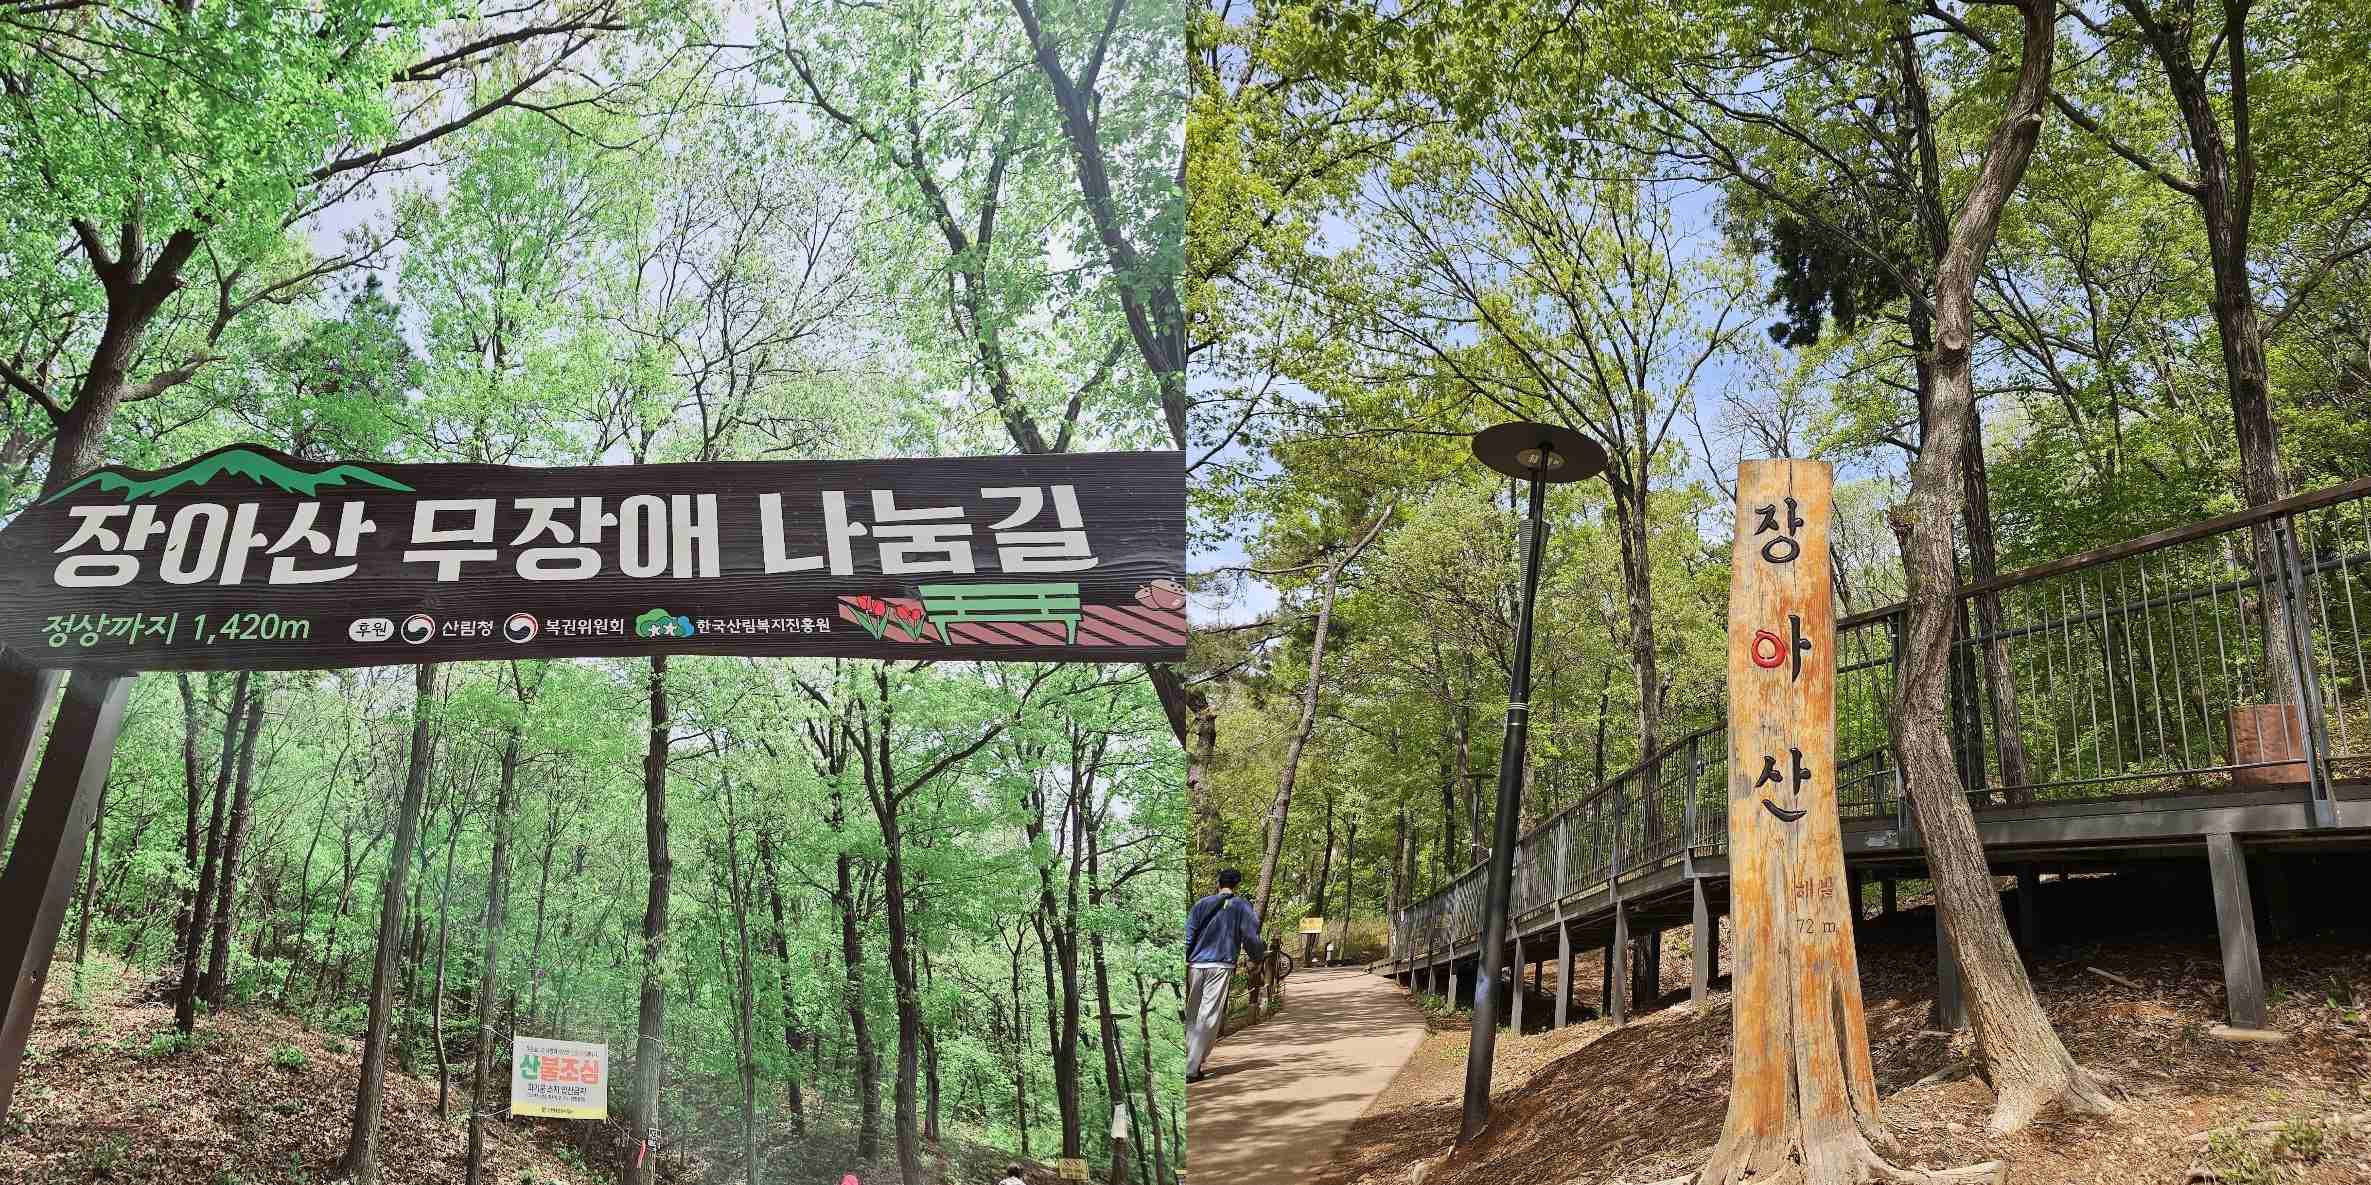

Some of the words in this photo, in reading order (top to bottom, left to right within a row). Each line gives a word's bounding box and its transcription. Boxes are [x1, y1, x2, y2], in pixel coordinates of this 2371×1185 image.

[53, 501, 377, 588] 장아산
[402, 493, 721, 582] 무장애
[759, 484, 1099, 575] 나눔길
[41, 612, 179, 648] 정상까지
[193, 613, 310, 645] 1,420m
[355, 618, 390, 638] 후원
[441, 619, 495, 638] 산림청
[545, 617, 625, 637] 복권위원회
[695, 616, 832, 634] 한국산림복지진흥원
[1751, 496, 1813, 824] 장아산
[1796, 918, 1815, 934] 72
[519, 1055, 600, 1084] 산불조심
